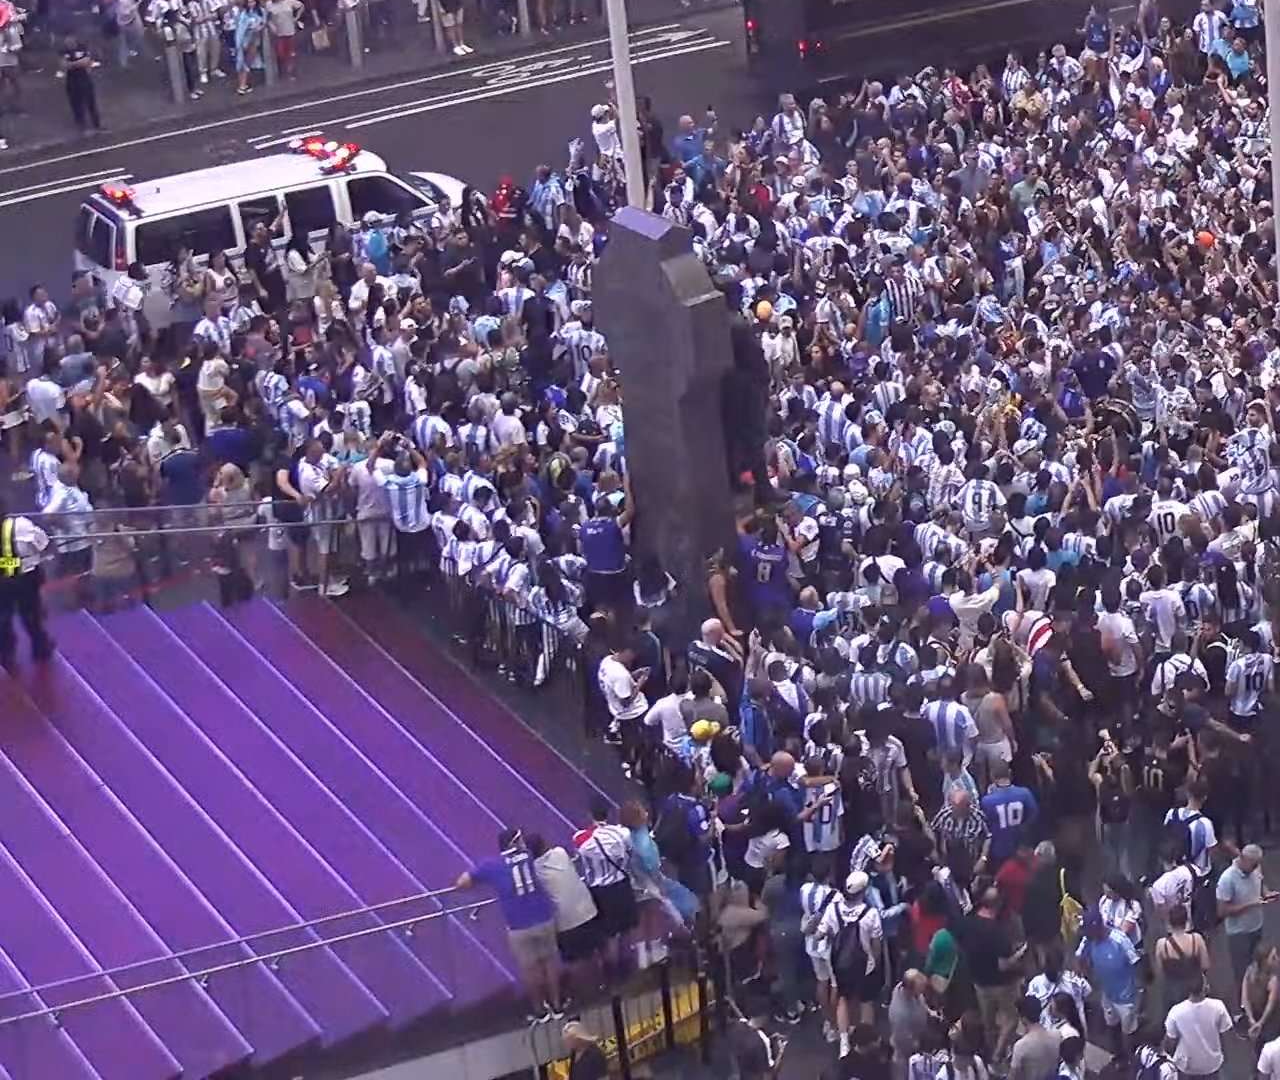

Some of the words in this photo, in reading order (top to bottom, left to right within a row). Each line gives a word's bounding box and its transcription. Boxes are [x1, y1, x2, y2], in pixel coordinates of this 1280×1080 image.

[1157, 511, 1176, 535] 10
[995, 801, 1023, 830] 10
[513, 863, 535, 896] 11
